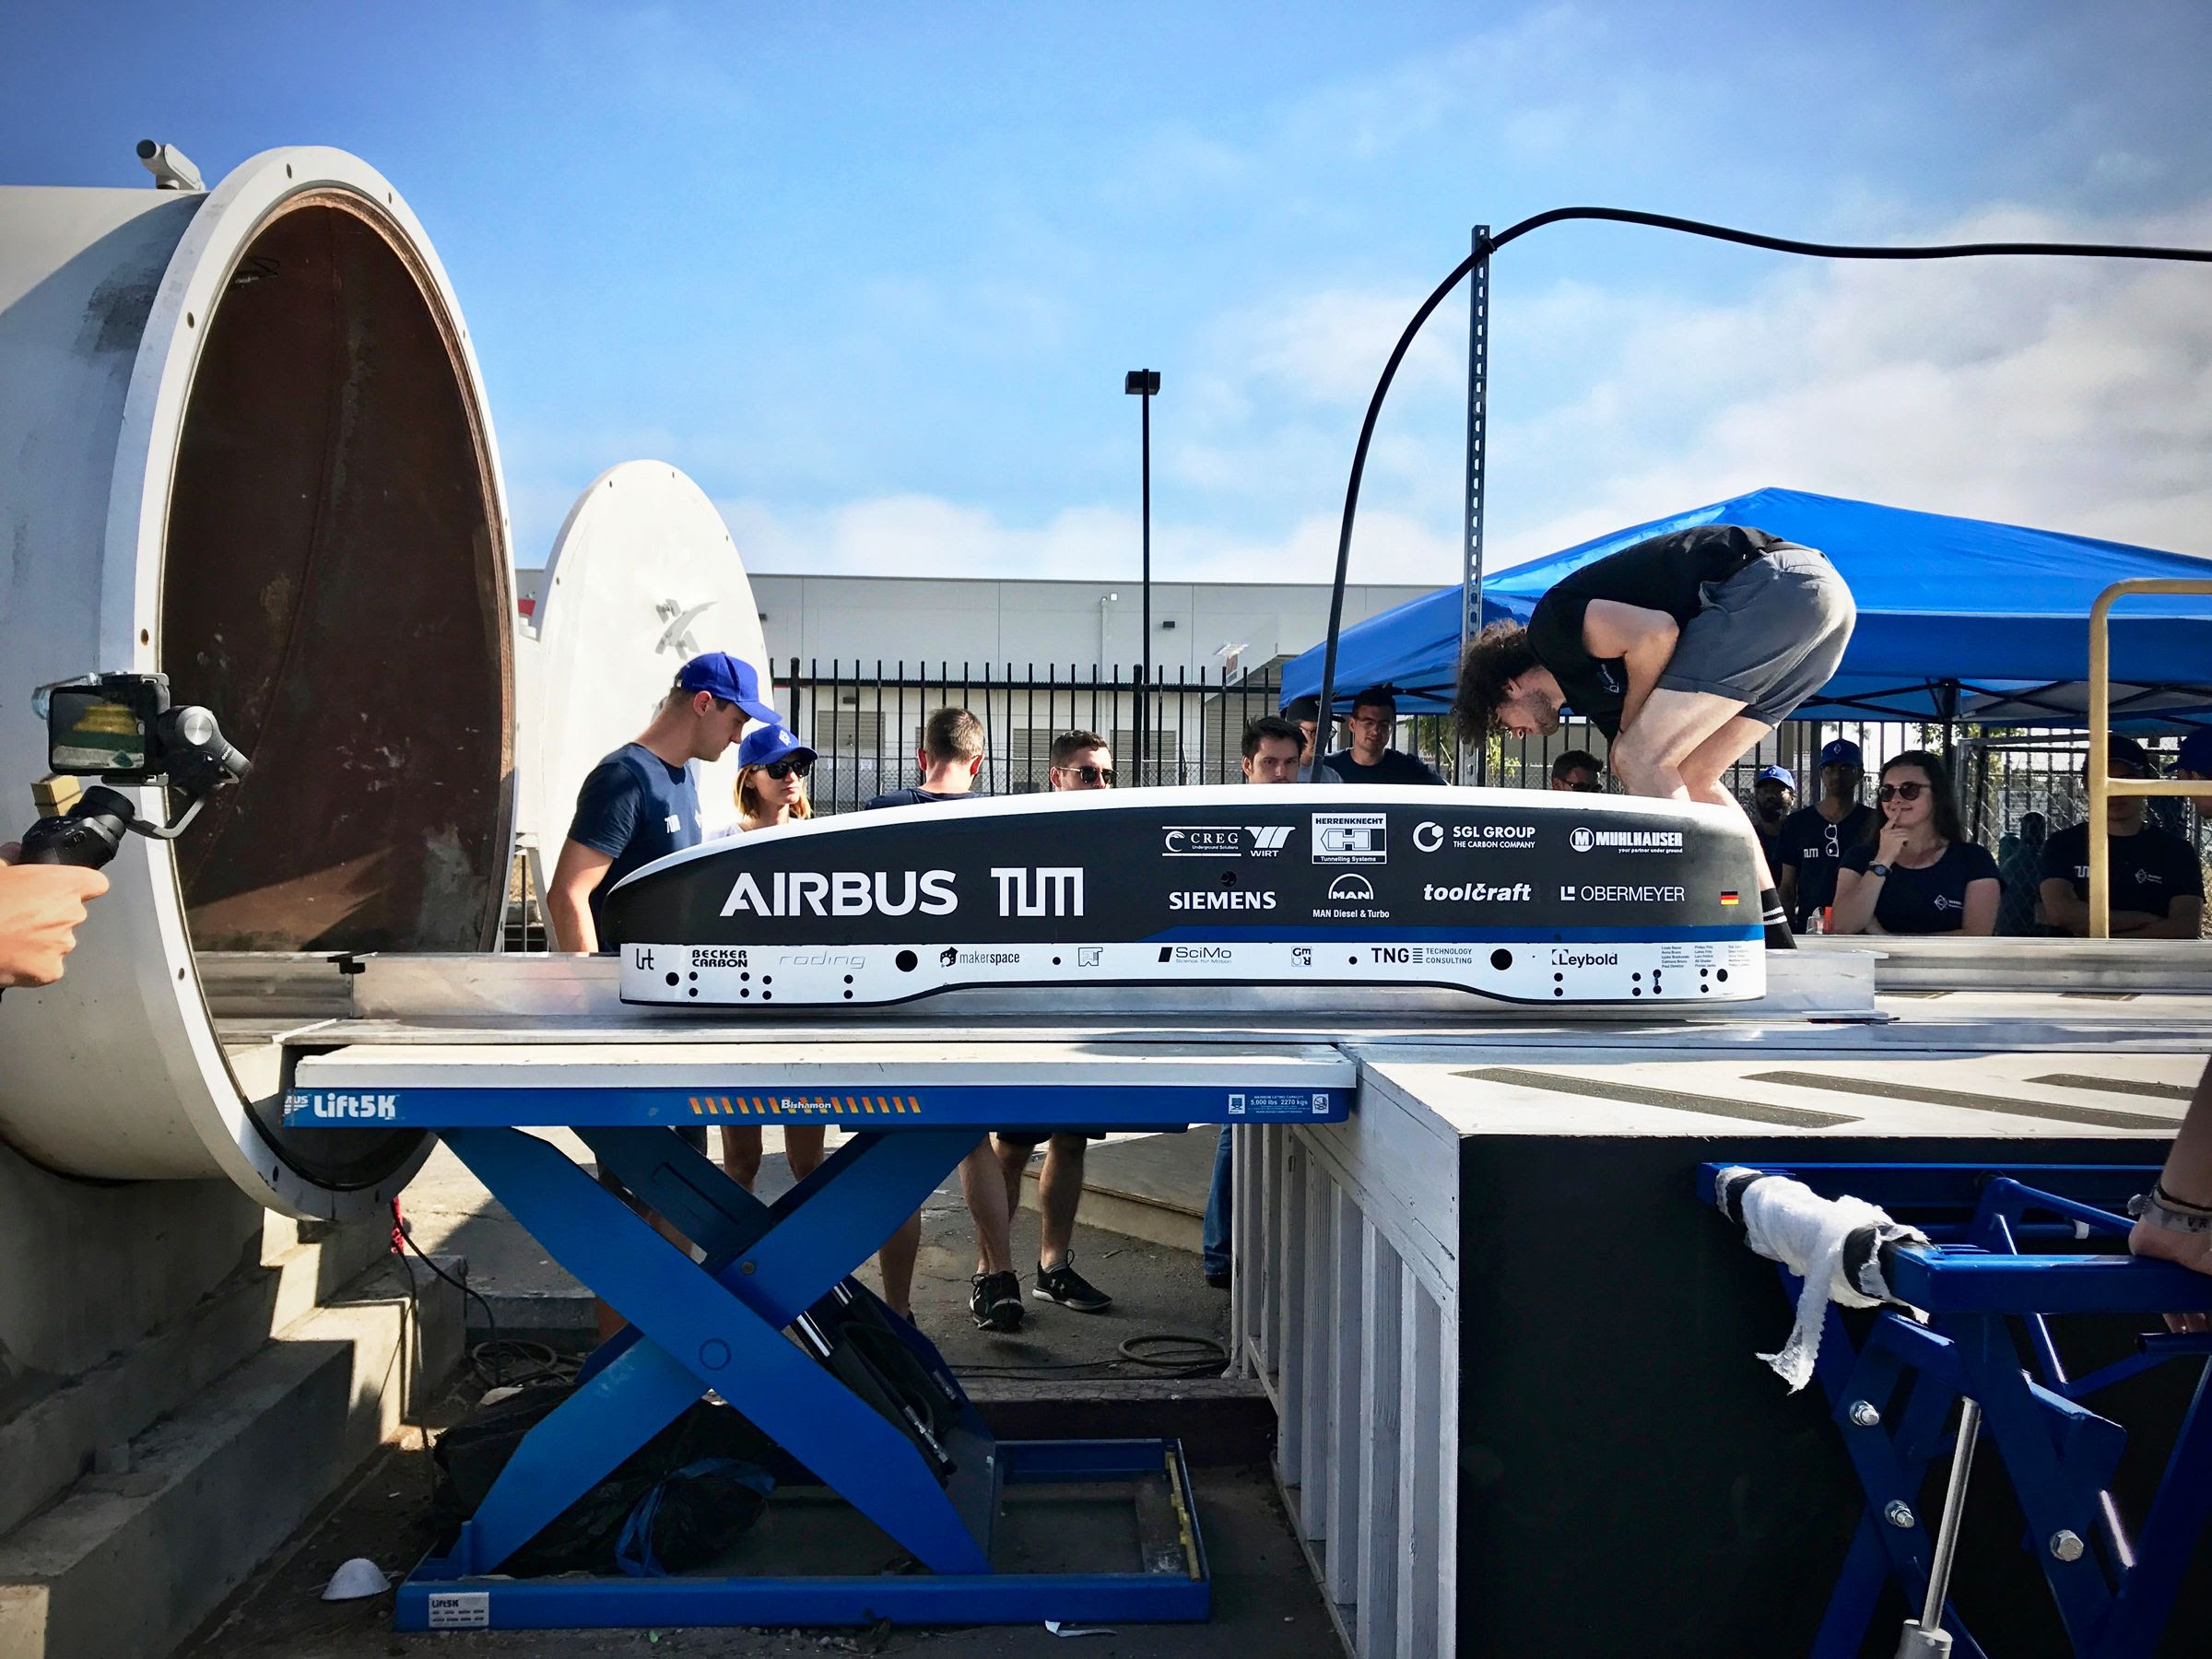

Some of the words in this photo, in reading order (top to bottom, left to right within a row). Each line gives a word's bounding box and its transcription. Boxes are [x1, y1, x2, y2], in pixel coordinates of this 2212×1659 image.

[1190, 832, 1239, 844] CREG
[1453, 827, 1479, 839] SGL
[1483, 827, 1536, 839] GROUP
[720, 869, 959, 918] AIRBUS
[990, 867, 1084, 917] TUM
[1332, 891, 1371, 900] MAN
[1581, 885, 1686, 902] OBERMEYER
[1169, 891, 1277, 910] SIEMENS
[1312, 909, 1332, 918] MAN
[1333, 909, 1358, 918] Diesel
[1359, 909, 1367, 918] &
[1367, 909, 1390, 918] Turbo
[692, 949, 747, 959] BECKER
[1175, 947, 1232, 959] SciMo
[1371, 947, 1409, 964] TNG
[1426, 947, 1472, 956] TECHNOLOGY
[692, 959, 748, 968] CARBON
[780, 950, 866, 970] roding
[959, 951, 1020, 966] makerspace
[1426, 957, 1472, 965] CONSULTING
[1559, 953, 1618, 969] Leybold
[313, 1092, 396, 1119] Lift5K
[781, 1099, 831, 1109] Bishamon
